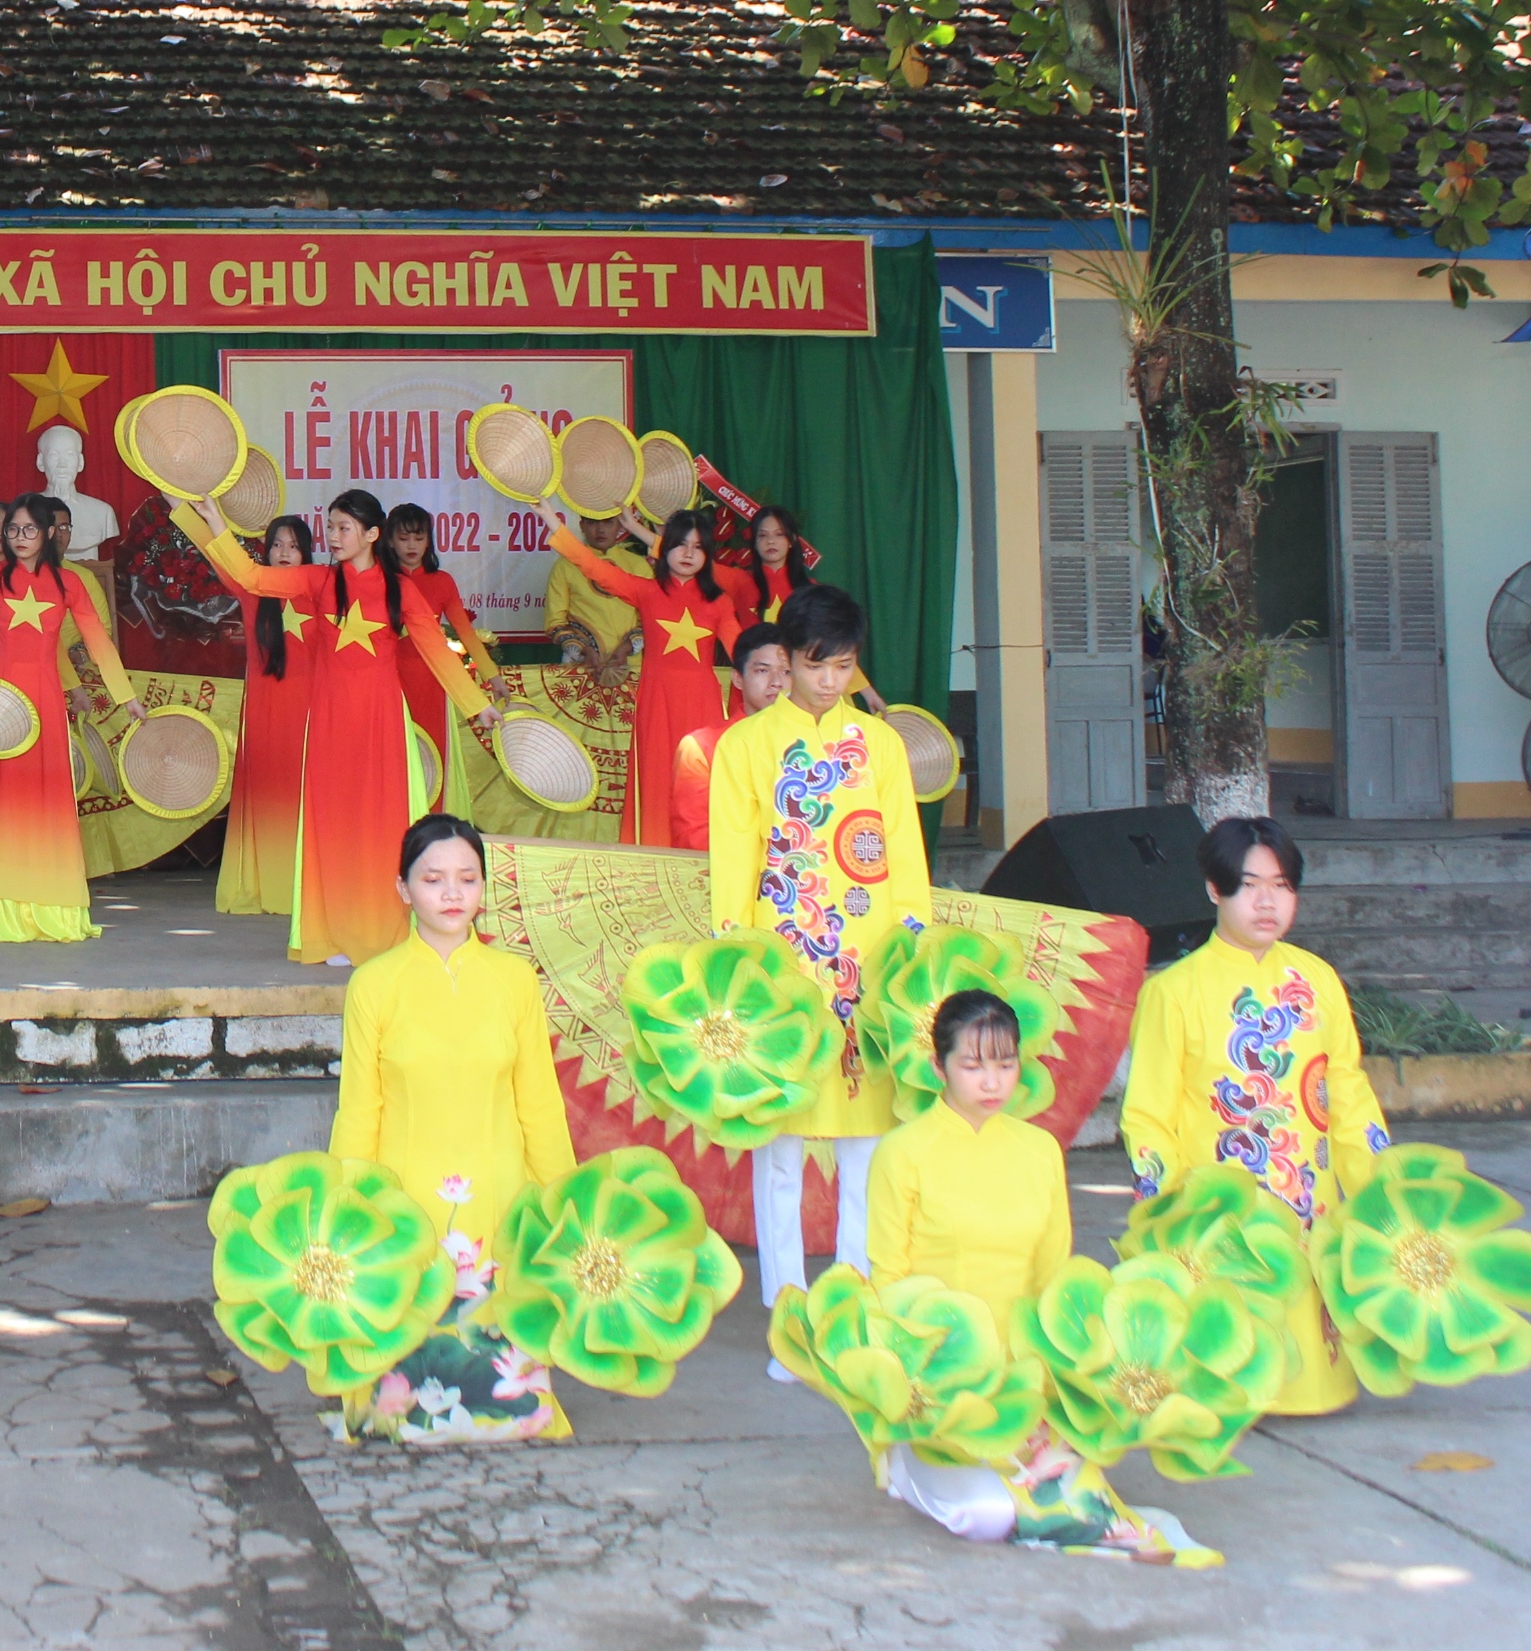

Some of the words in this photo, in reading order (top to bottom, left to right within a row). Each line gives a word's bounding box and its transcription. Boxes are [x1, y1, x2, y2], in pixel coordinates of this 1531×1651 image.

[87, 248, 187, 316] HỘI
[209, 242, 327, 307] CHỦ
[354, 250, 530, 307] NGHĨA
[547, 251, 678, 317] VIỆT
[701, 264, 824, 311] NAM
[284, 381, 332, 480] LỄ
[349, 411, 440, 480] KHAI
[430, 512, 481, 552] 022
[508, 511, 566, 552] 202
[470, 593, 483, 608] 08
[486, 592, 521, 612] tháng
[524, 592, 532, 608] 9
